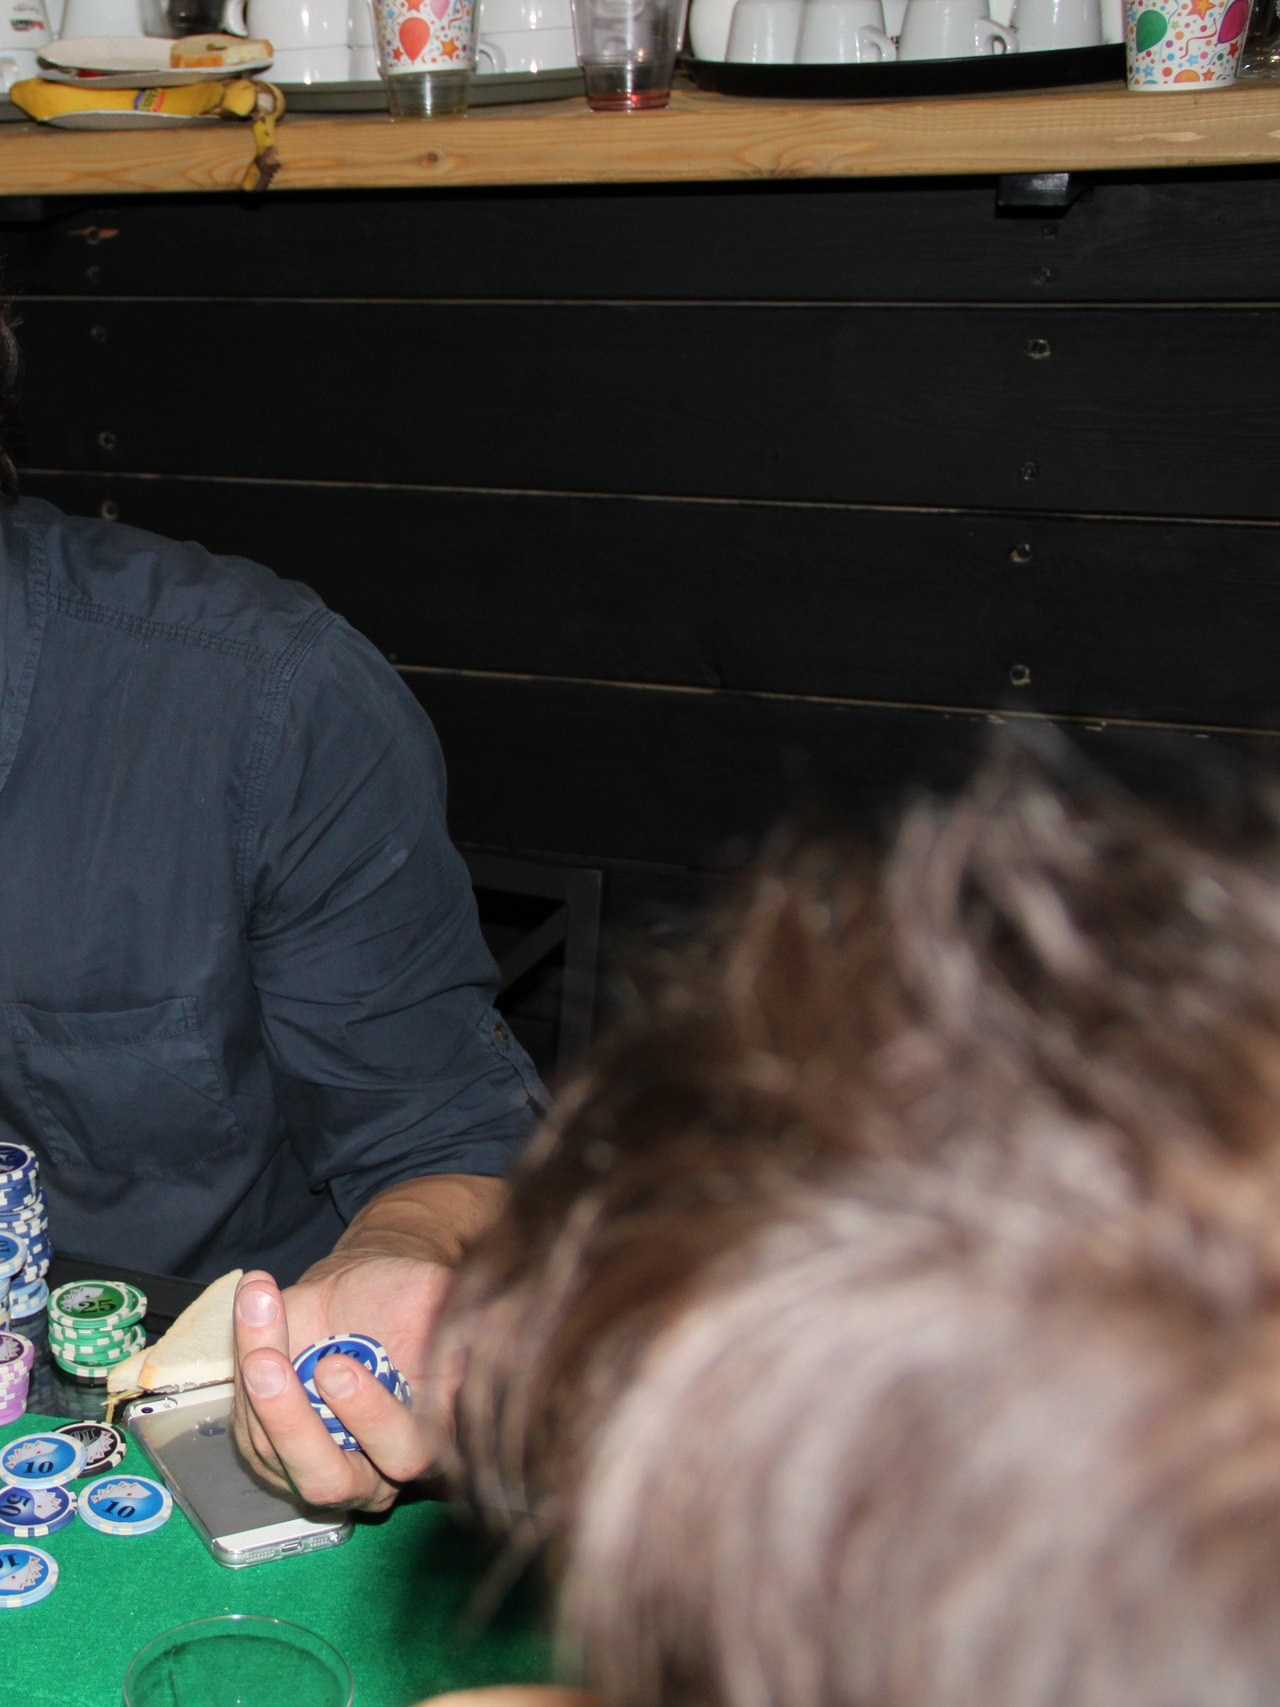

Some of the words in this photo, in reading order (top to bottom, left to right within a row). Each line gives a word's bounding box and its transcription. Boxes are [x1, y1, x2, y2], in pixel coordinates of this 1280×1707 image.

[79, 1299, 116, 1314] 25
[23, 1461, 54, 1474] 10
[101, 1500, 136, 1519] 10
